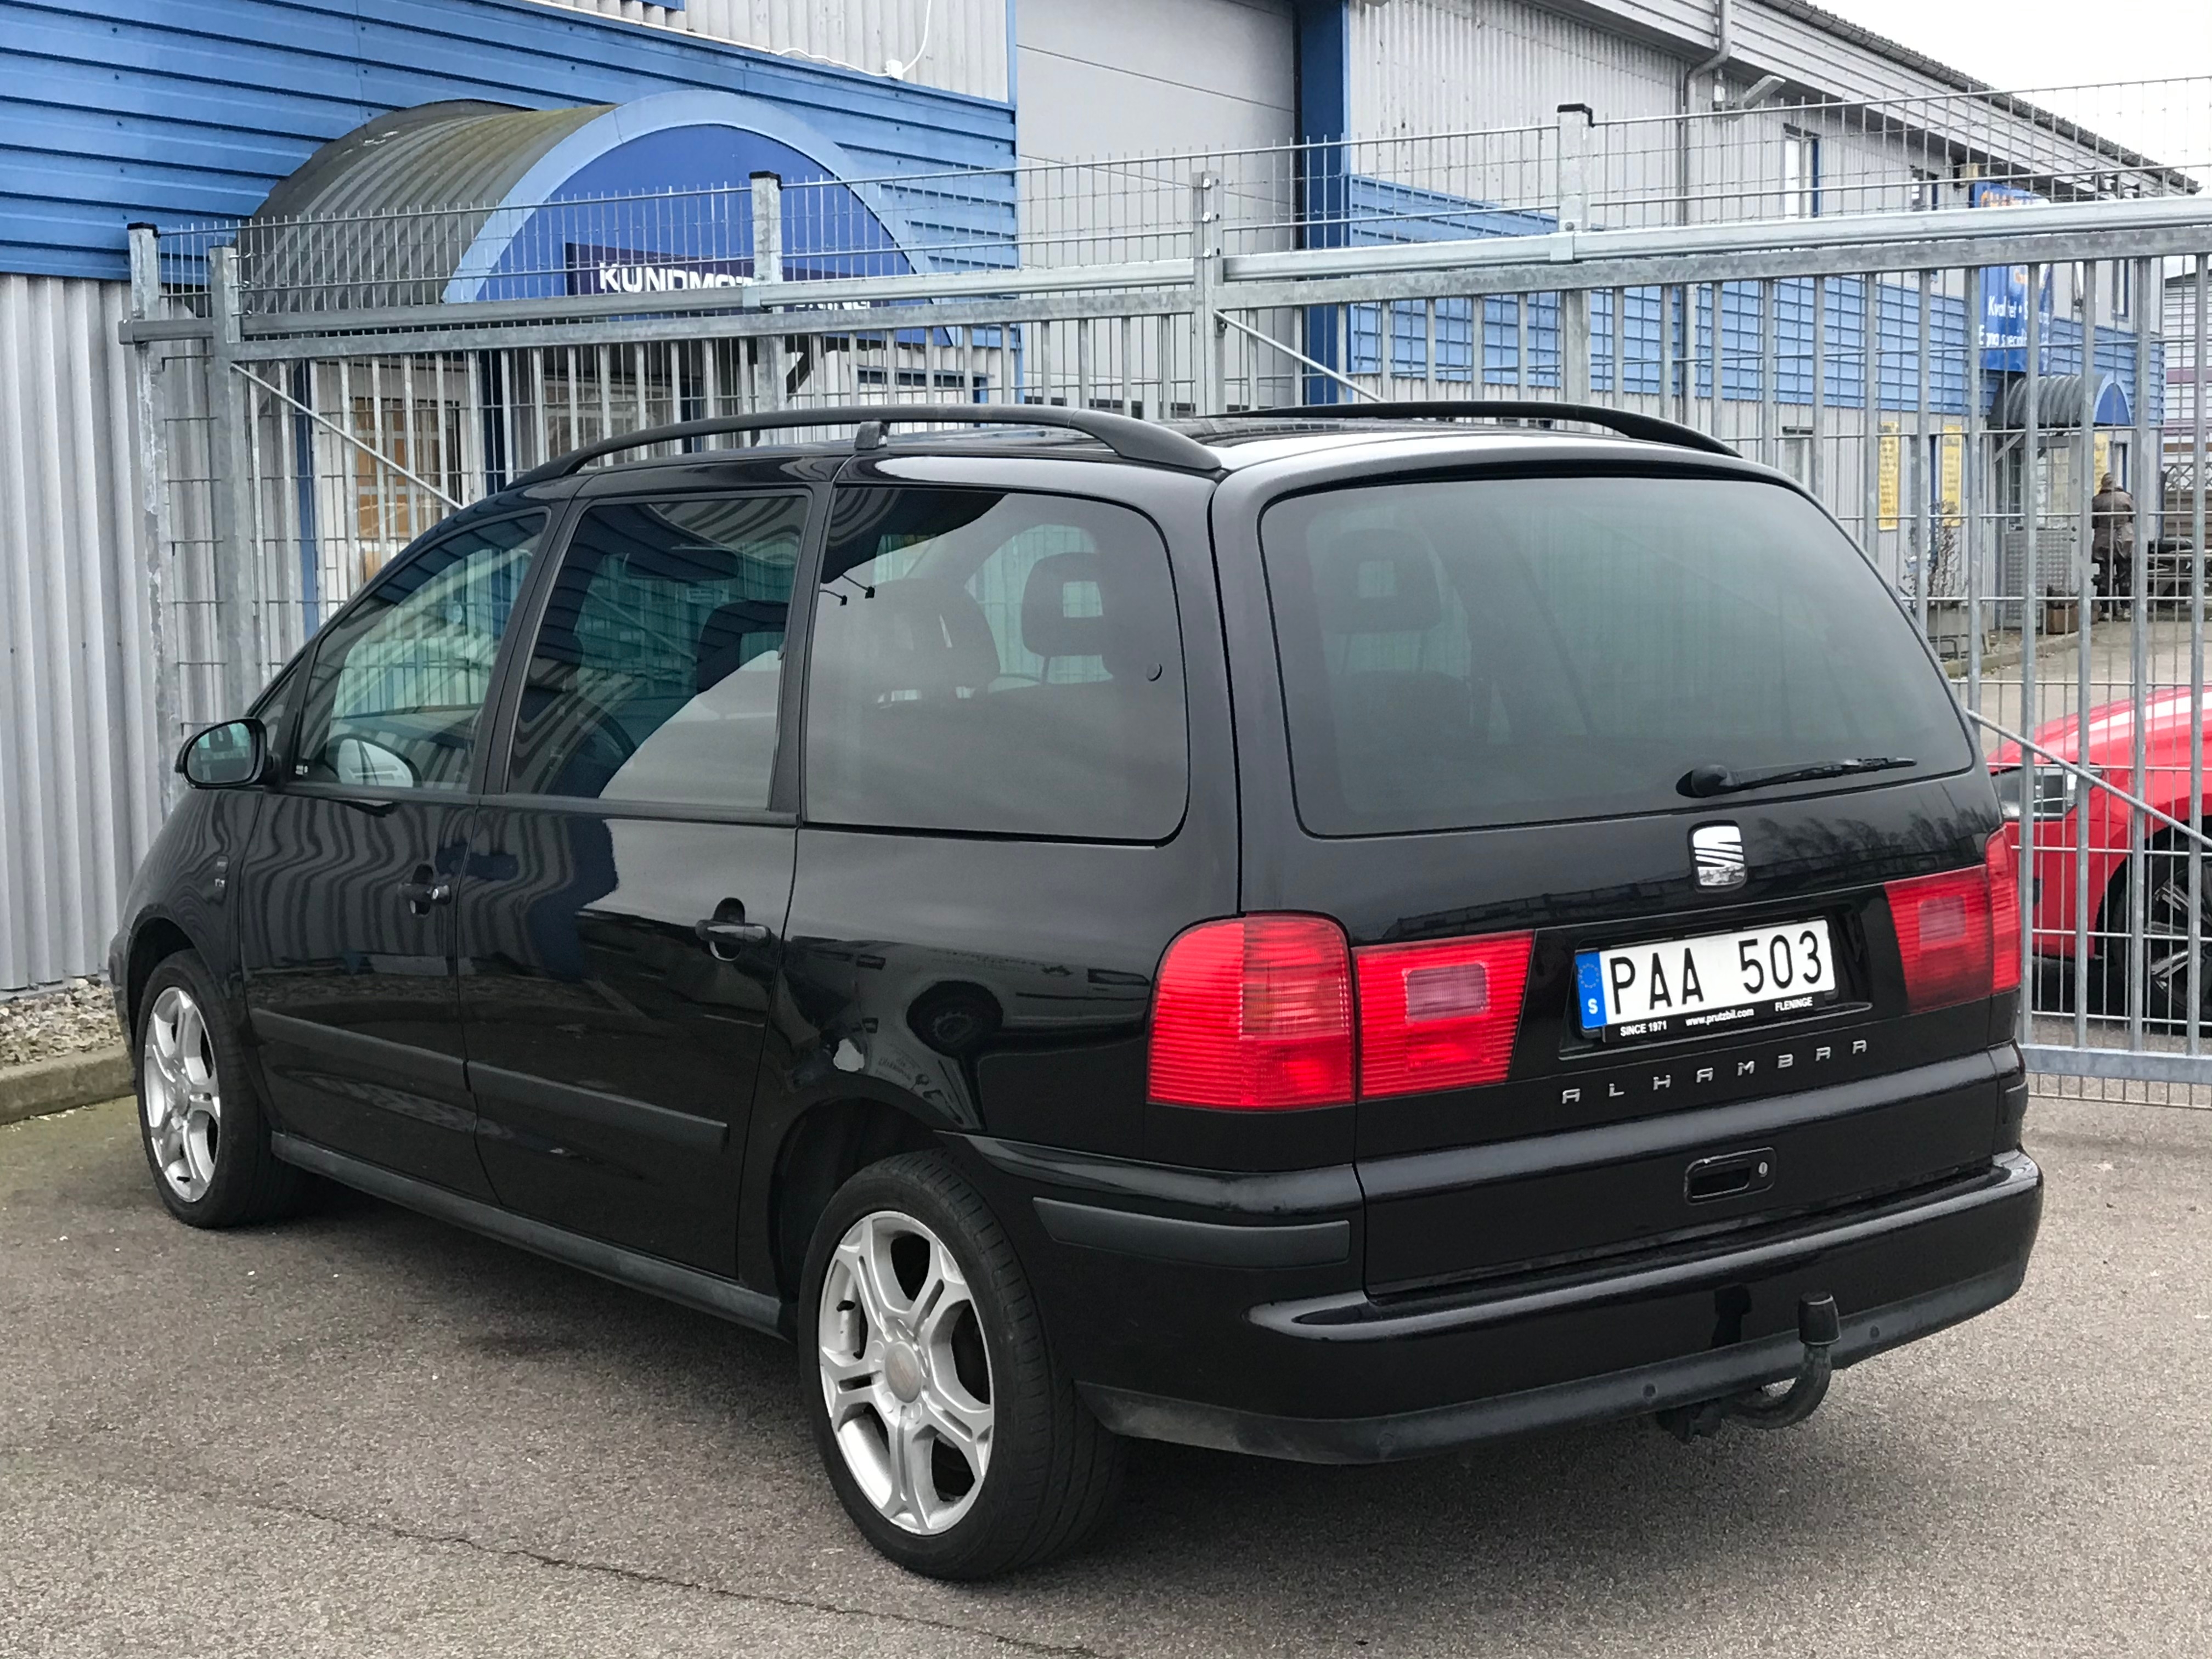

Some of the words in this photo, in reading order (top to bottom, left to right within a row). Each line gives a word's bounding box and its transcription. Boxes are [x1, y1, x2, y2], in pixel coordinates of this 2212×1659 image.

[1610, 947, 1704, 1015] PAA
[1738, 930, 1822, 994] 503
[1588, 998, 1598, 1014] S
[1775, 996, 1813, 1012] FLENINGE
[1620, 1023, 1647, 1037] SINCE
[1648, 1020, 1667, 1032] 1971
[1561, 1039, 1867, 1104] ALHAMBRA
